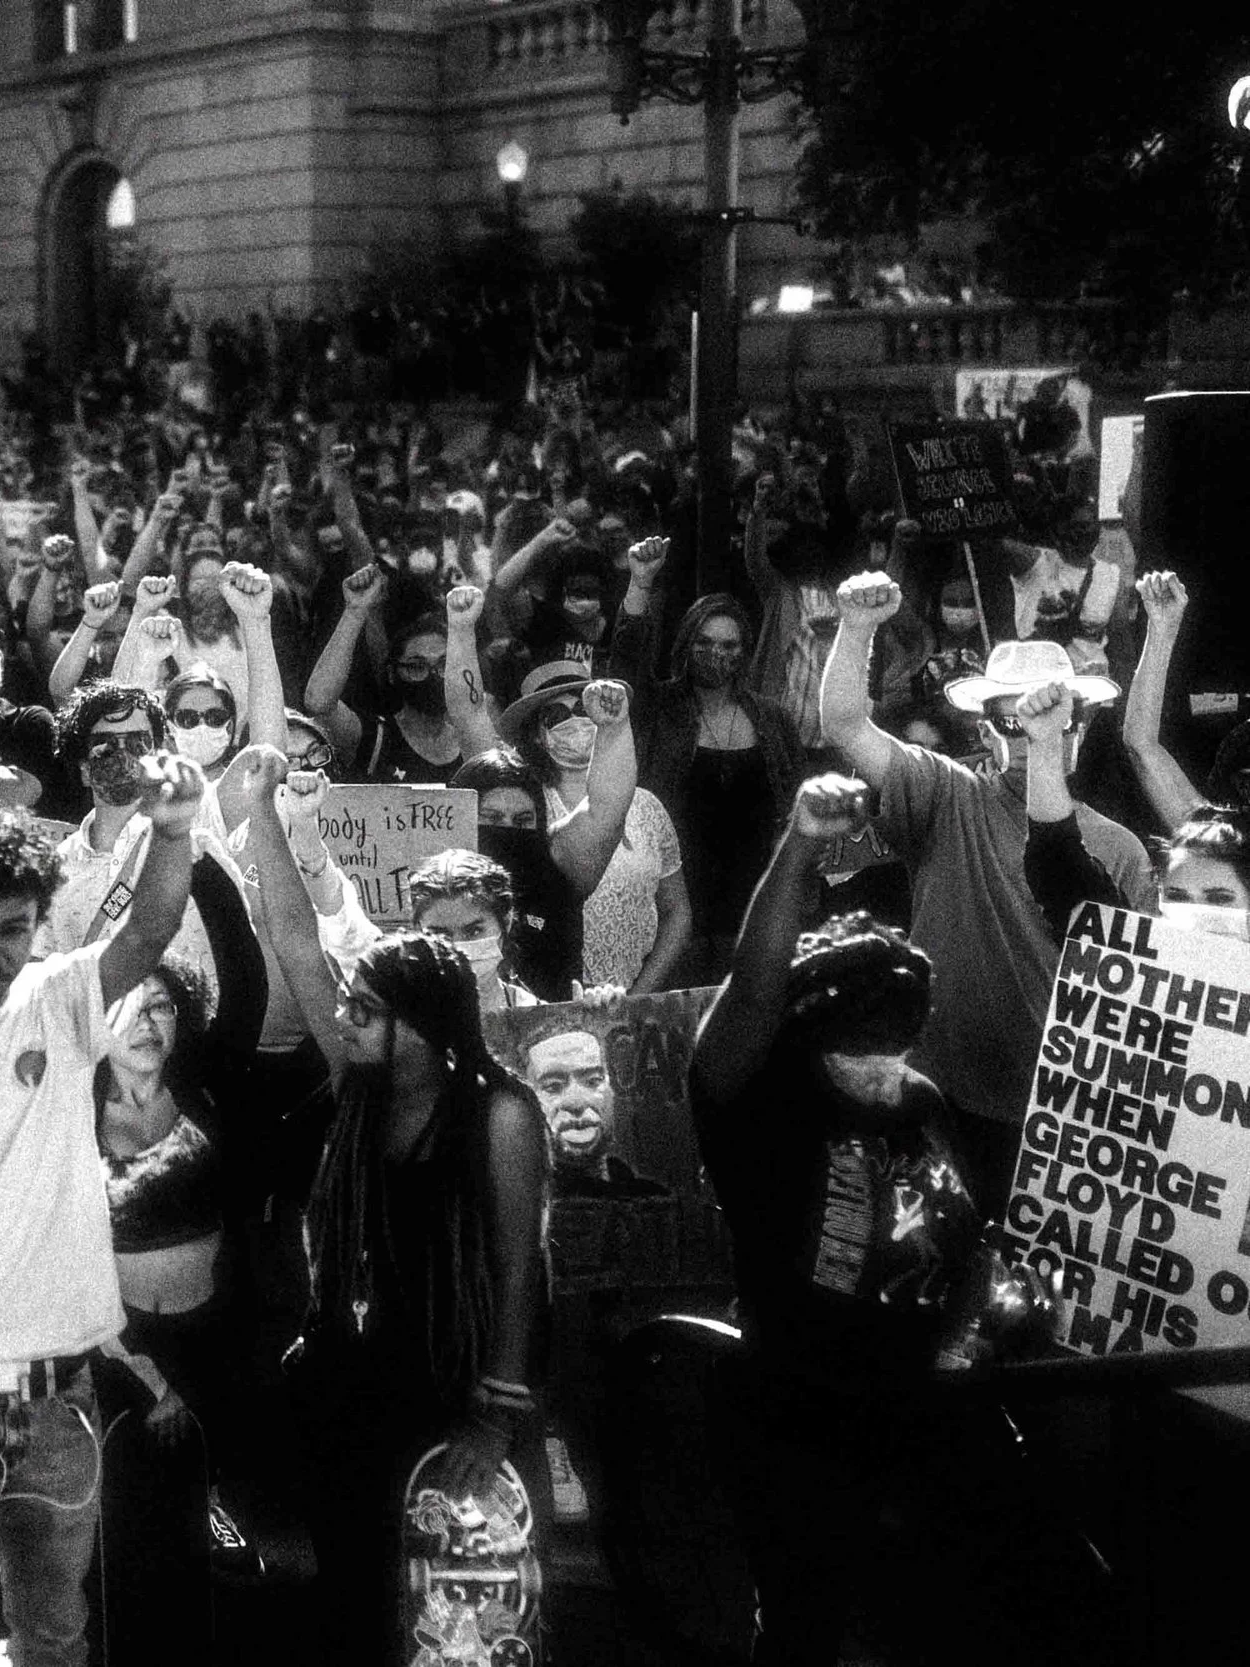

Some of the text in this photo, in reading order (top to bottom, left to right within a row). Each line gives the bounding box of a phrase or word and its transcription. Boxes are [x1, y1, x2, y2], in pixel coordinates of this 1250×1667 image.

[383, 806, 406, 831] is
[405, 801, 454, 832] FREE
[338, 844, 378, 869] until
[350, 873, 390, 915] ALL
[1068, 902, 1159, 961] ALL
[1055, 980, 1194, 1066] WERE
[1036, 1065, 1177, 1152] WHEN
[1015, 1149, 1175, 1244] FLOYD
[1024, 1112, 1227, 1220] GEORGE
[1007, 1194, 1250, 1322] CALLED O
[1110, 1279, 1199, 1349] HIS
